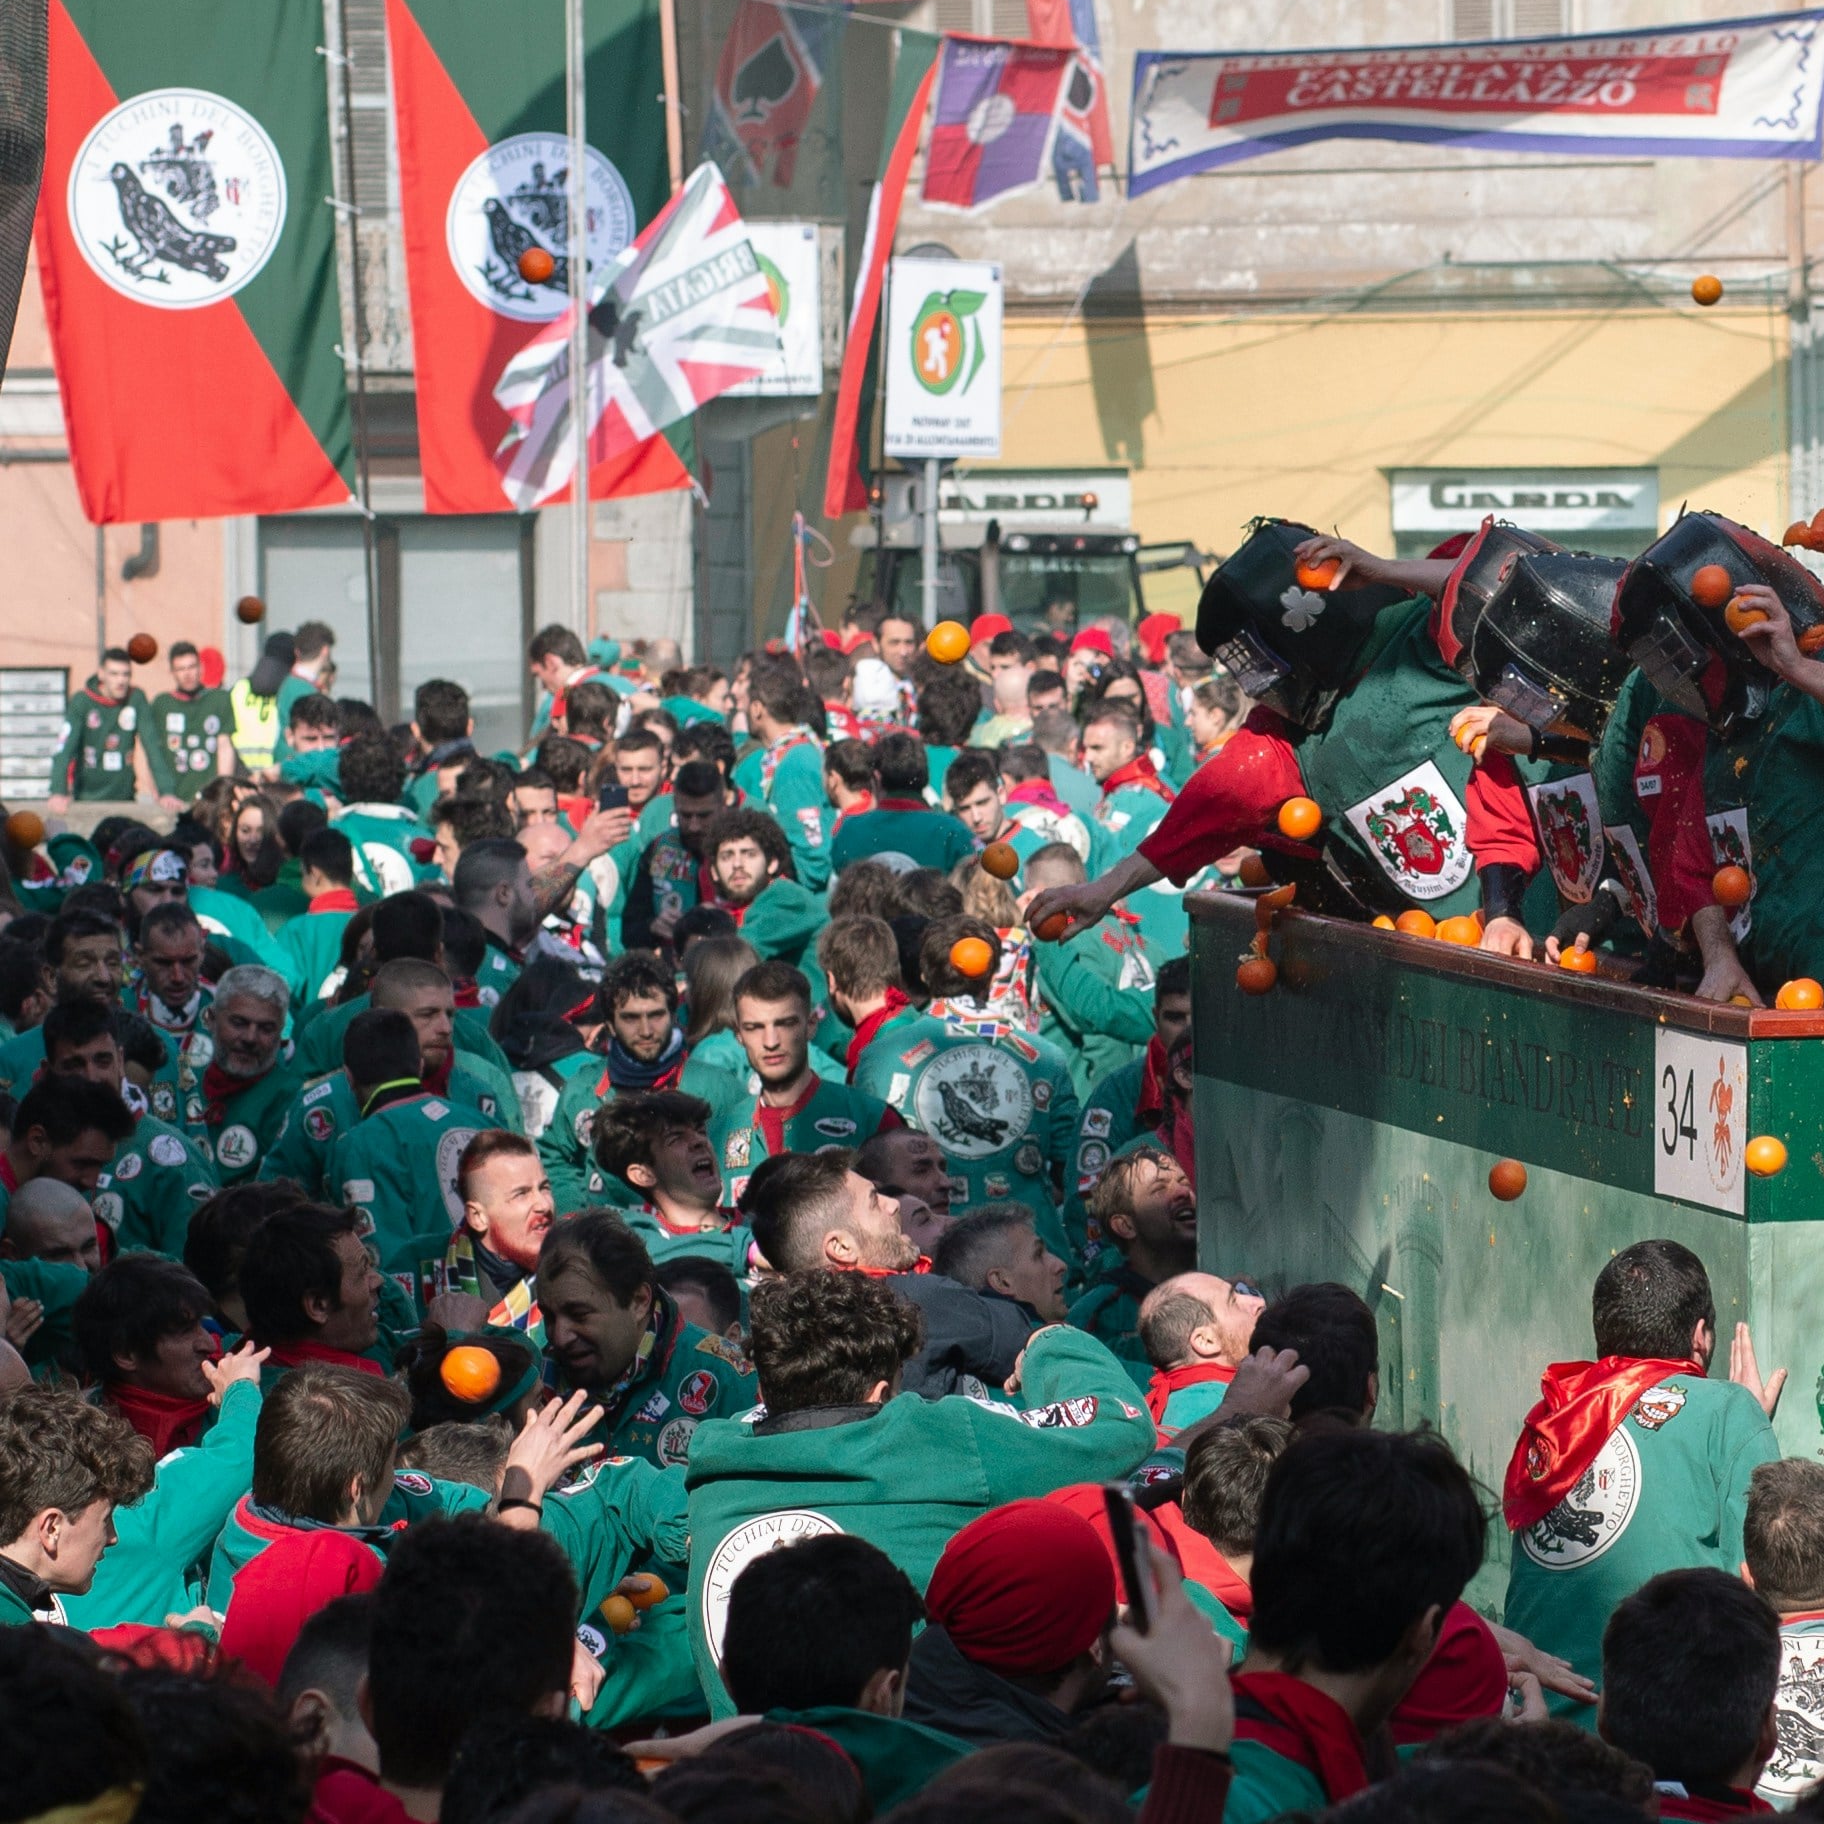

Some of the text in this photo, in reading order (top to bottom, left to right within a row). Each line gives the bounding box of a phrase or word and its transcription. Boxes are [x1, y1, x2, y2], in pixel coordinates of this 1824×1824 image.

[1285, 78, 1637, 108] CASTELLAZZO
[1294, 61, 1573, 86] FAGIOLATA
[1429, 477, 1636, 511] GARDA
[1458, 1026, 1646, 1140] BIANDRATE
[1661, 1064, 1699, 1162] 34
[1605, 1434, 1633, 1531] BORGHETTO
[716, 1517, 784, 1575] TUCHINI
